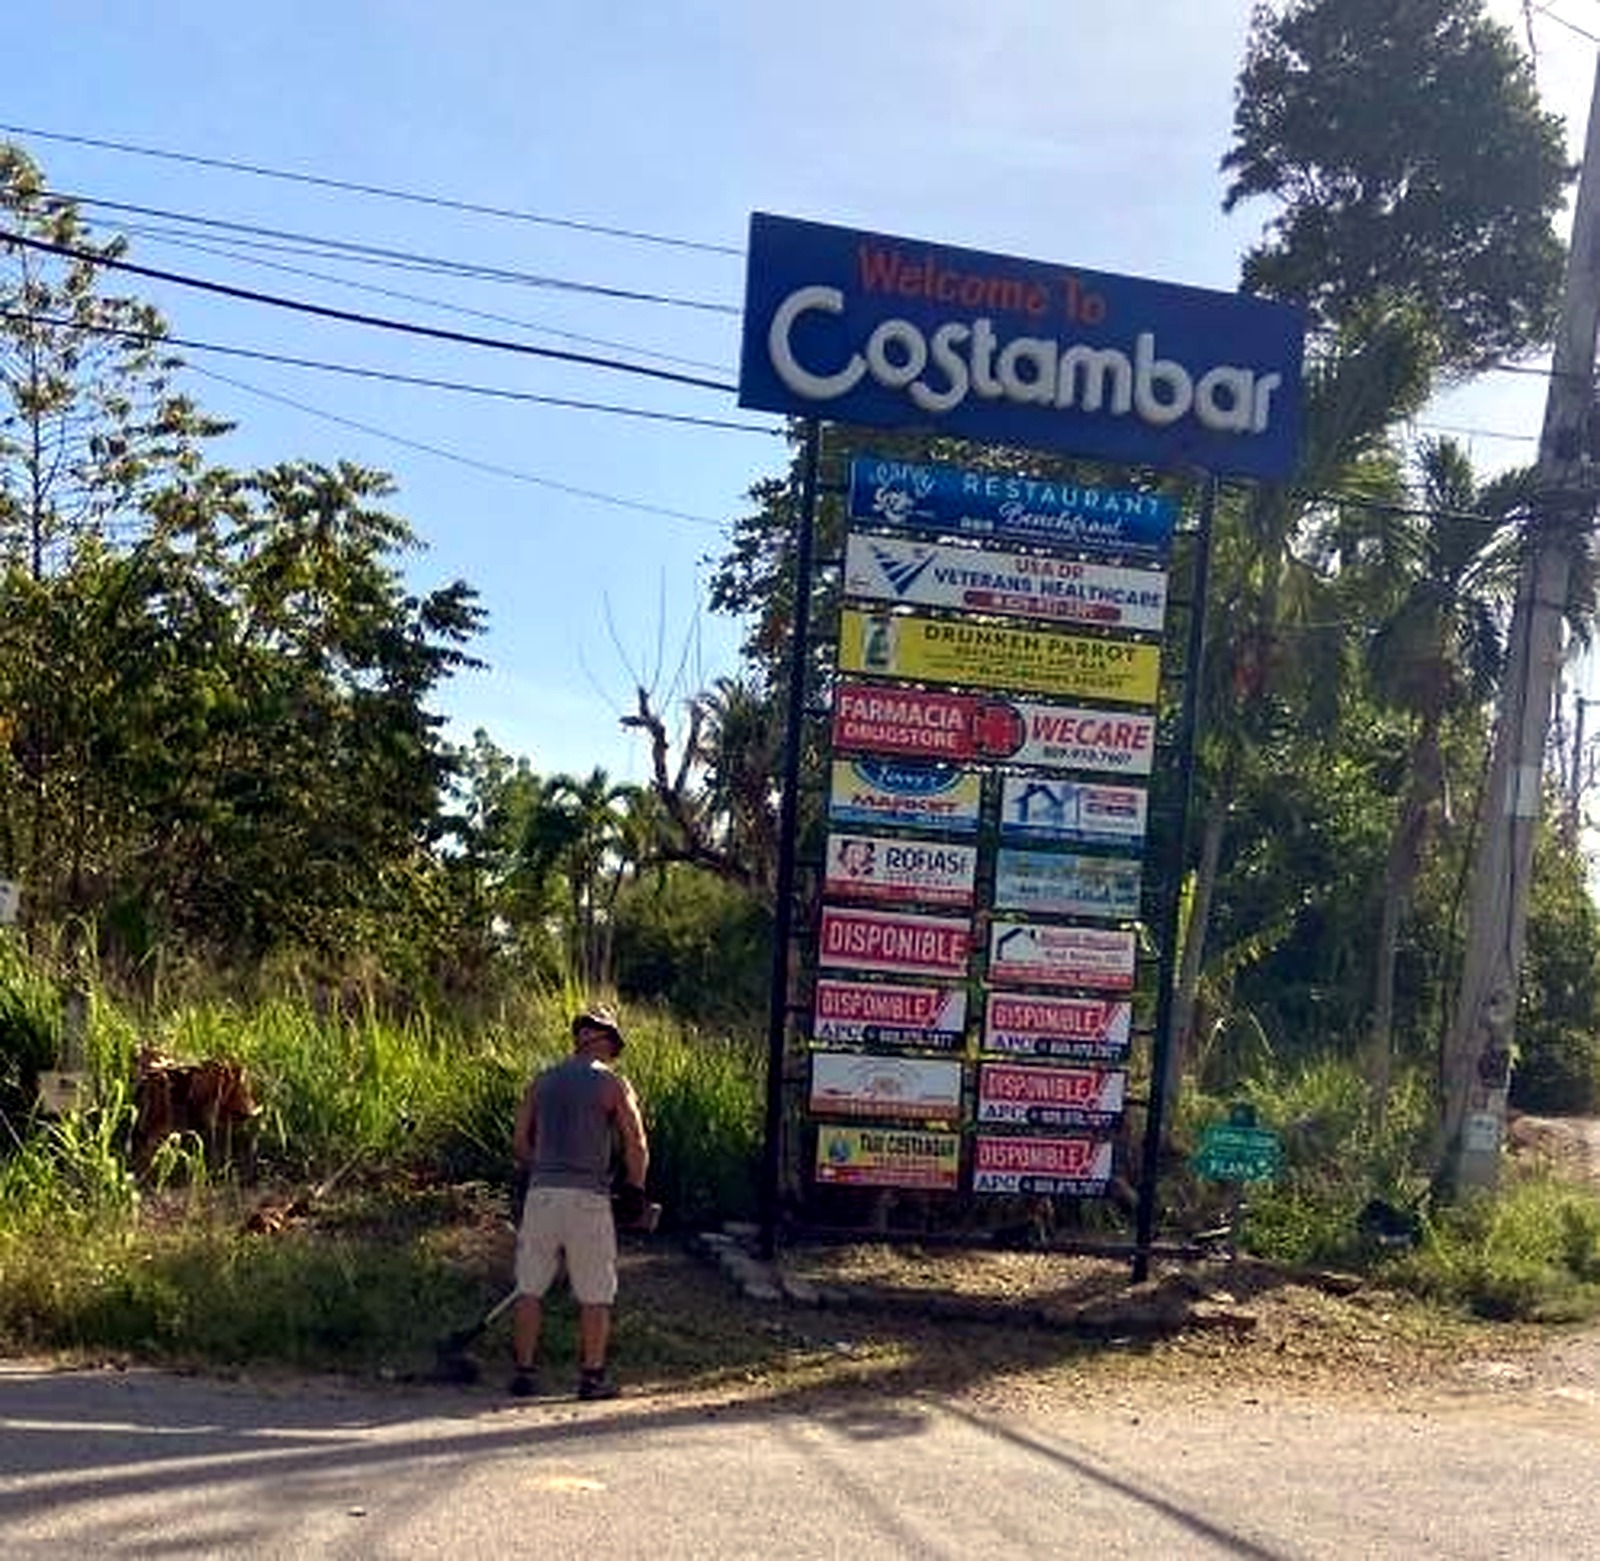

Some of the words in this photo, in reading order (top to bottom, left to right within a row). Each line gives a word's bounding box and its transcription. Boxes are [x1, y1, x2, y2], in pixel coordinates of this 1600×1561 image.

[858, 244, 1048, 313] Welcome
[1064, 276, 1105, 325] To
[768, 285, 1282, 434] Costambar
[962, 472, 1159, 515] RESTAURANT
[1015, 558, 1054, 576] USA
[934, 568, 1031, 592] VETERANS
[1040, 579, 1162, 607] HEALTHCARE
[923, 624, 1040, 651] DRUNKEN
[1047, 636, 1135, 662] PARROT
[839, 696, 965, 730] FARMACIA
[1031, 714, 1150, 750] WECARE
[844, 722, 957, 749] DRUGSTORE
[829, 921, 967, 963] DISPONIBLE
